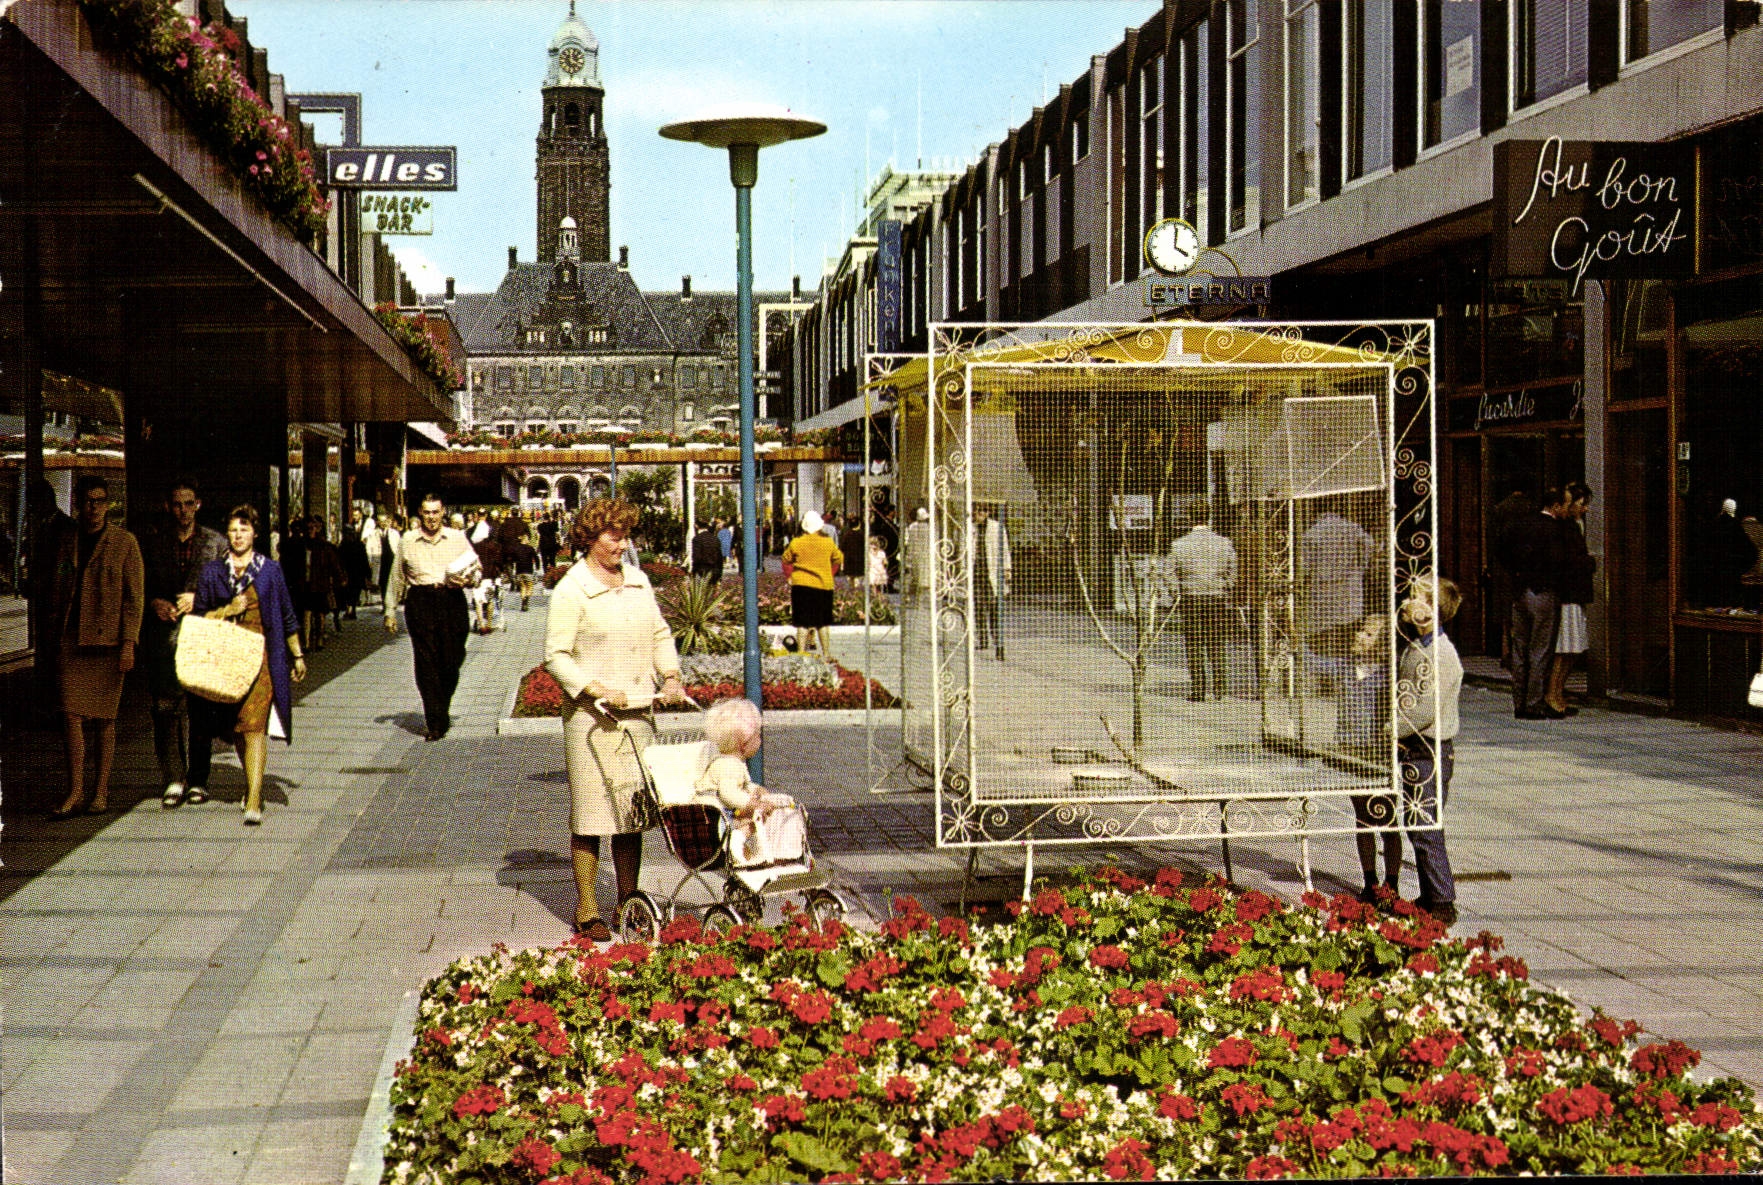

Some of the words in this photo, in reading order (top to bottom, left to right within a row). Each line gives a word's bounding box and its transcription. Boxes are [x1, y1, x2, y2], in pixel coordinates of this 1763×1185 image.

[335, 153, 447, 182] elles
[1514, 135, 1590, 224] Au
[1595, 157, 1679, 209] bon
[376, 213, 414, 232] BAR
[1551, 208, 1687, 298] Goût
[1150, 283, 1269, 302] ETERNA
